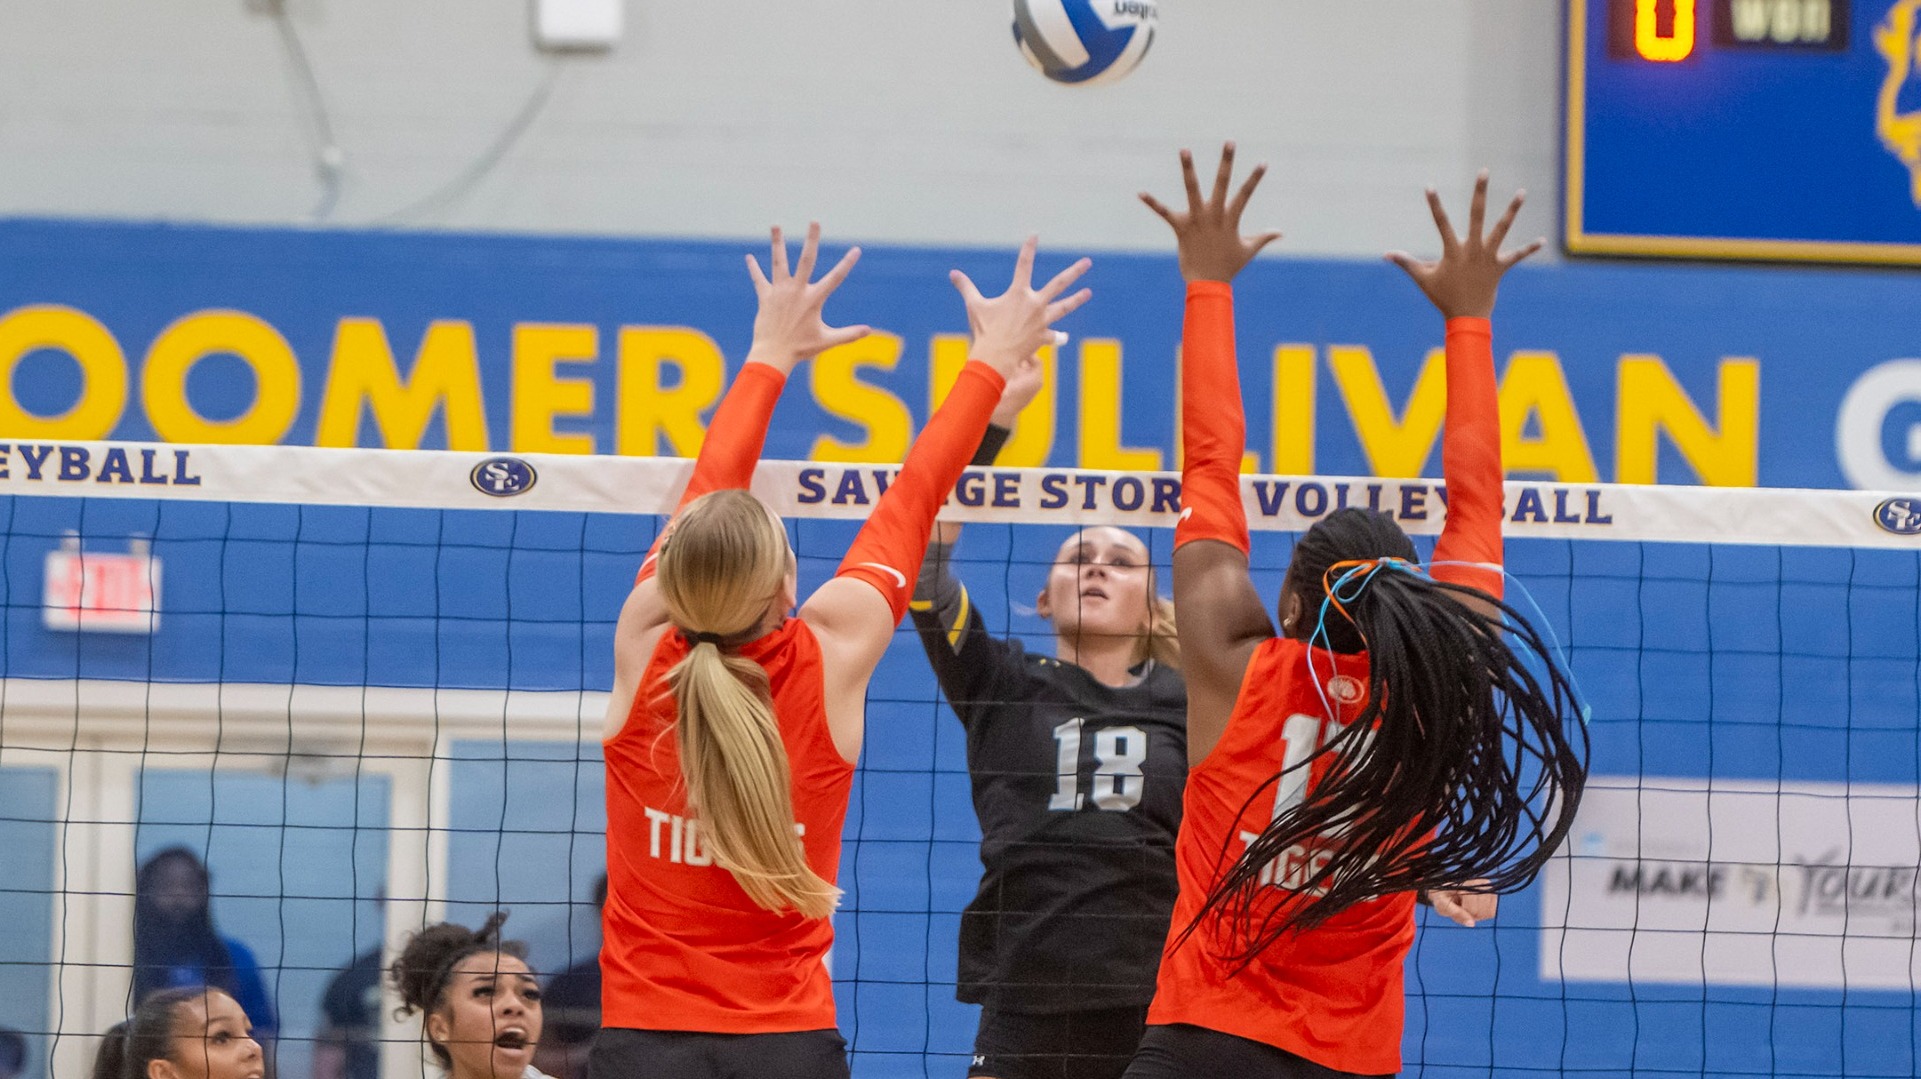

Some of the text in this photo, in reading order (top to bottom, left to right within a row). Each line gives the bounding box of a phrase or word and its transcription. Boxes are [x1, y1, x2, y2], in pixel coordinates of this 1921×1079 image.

[808, 328, 1761, 488] SULIVAN
[797, 467, 1613, 525] SAVGE STOR VOLLEALL
[1048, 717, 1147, 813] 18
[644, 806, 806, 868] TIG
[1239, 829, 1382, 904] TIGE
